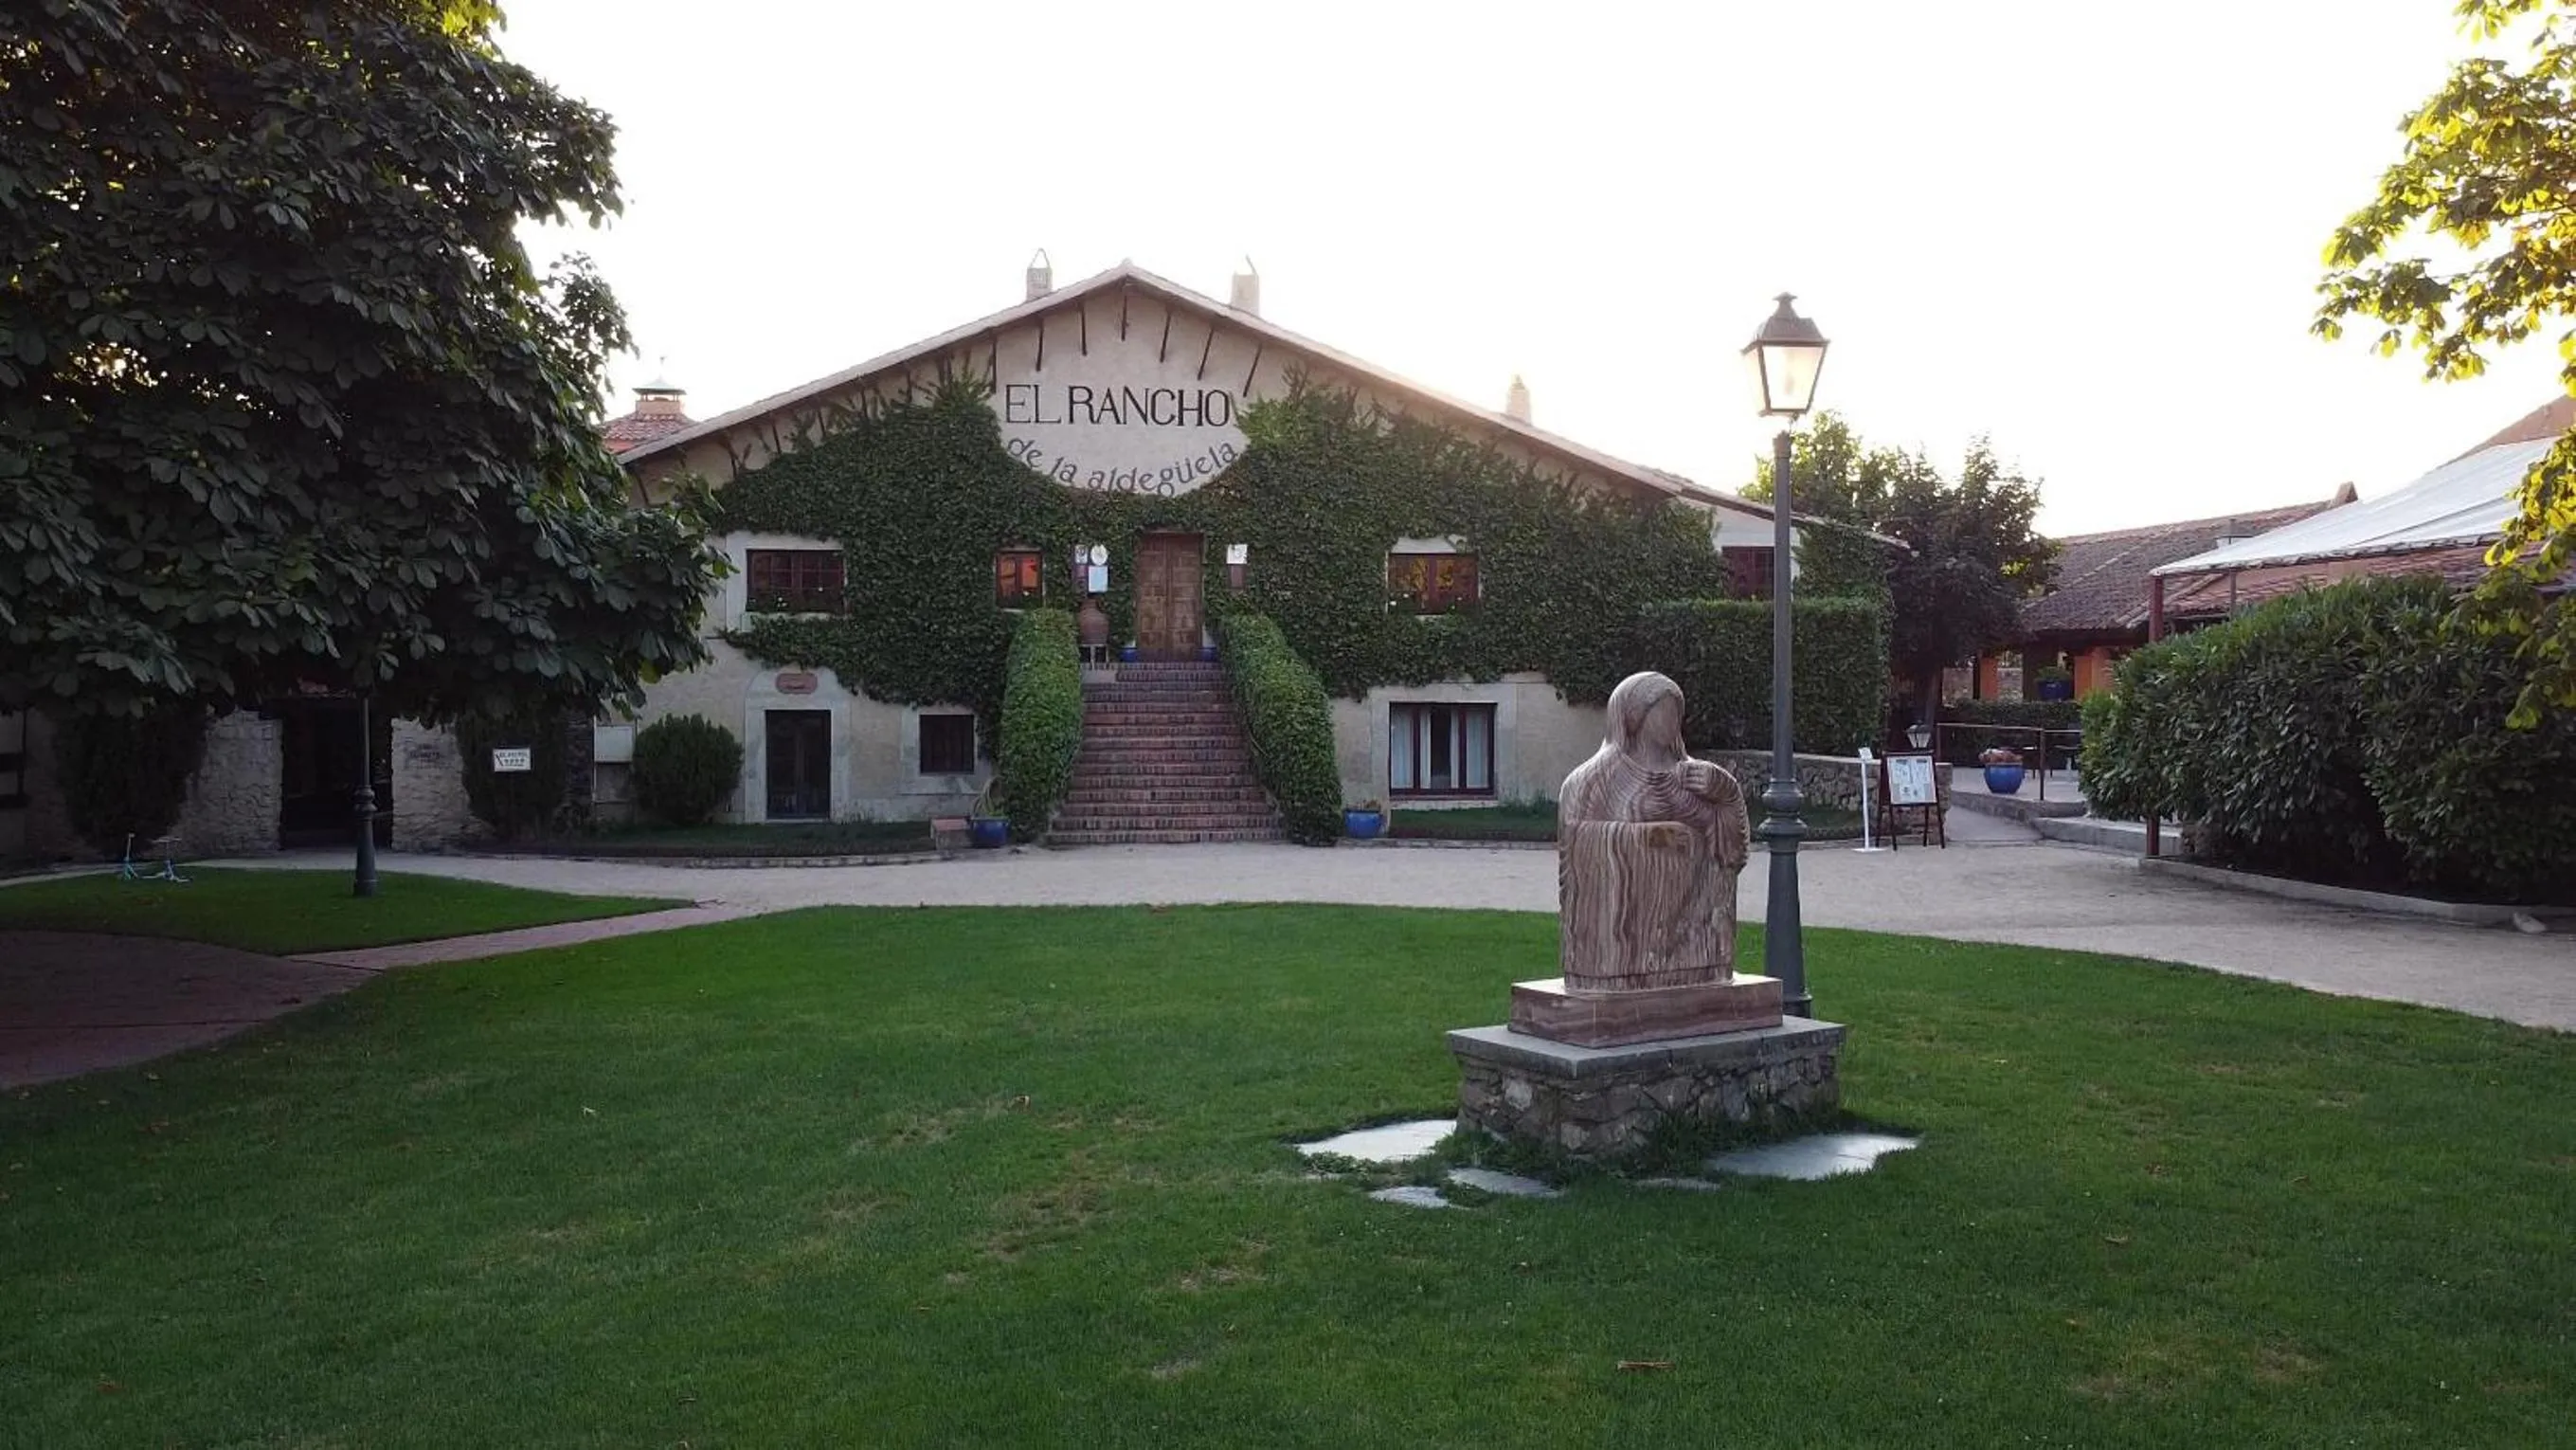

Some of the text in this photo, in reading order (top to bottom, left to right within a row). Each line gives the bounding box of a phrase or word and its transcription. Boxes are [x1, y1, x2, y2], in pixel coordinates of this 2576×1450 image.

[1005, 384, 1230, 426] EL RANCHO
[1007, 437, 1239, 498] de la aldegüela
